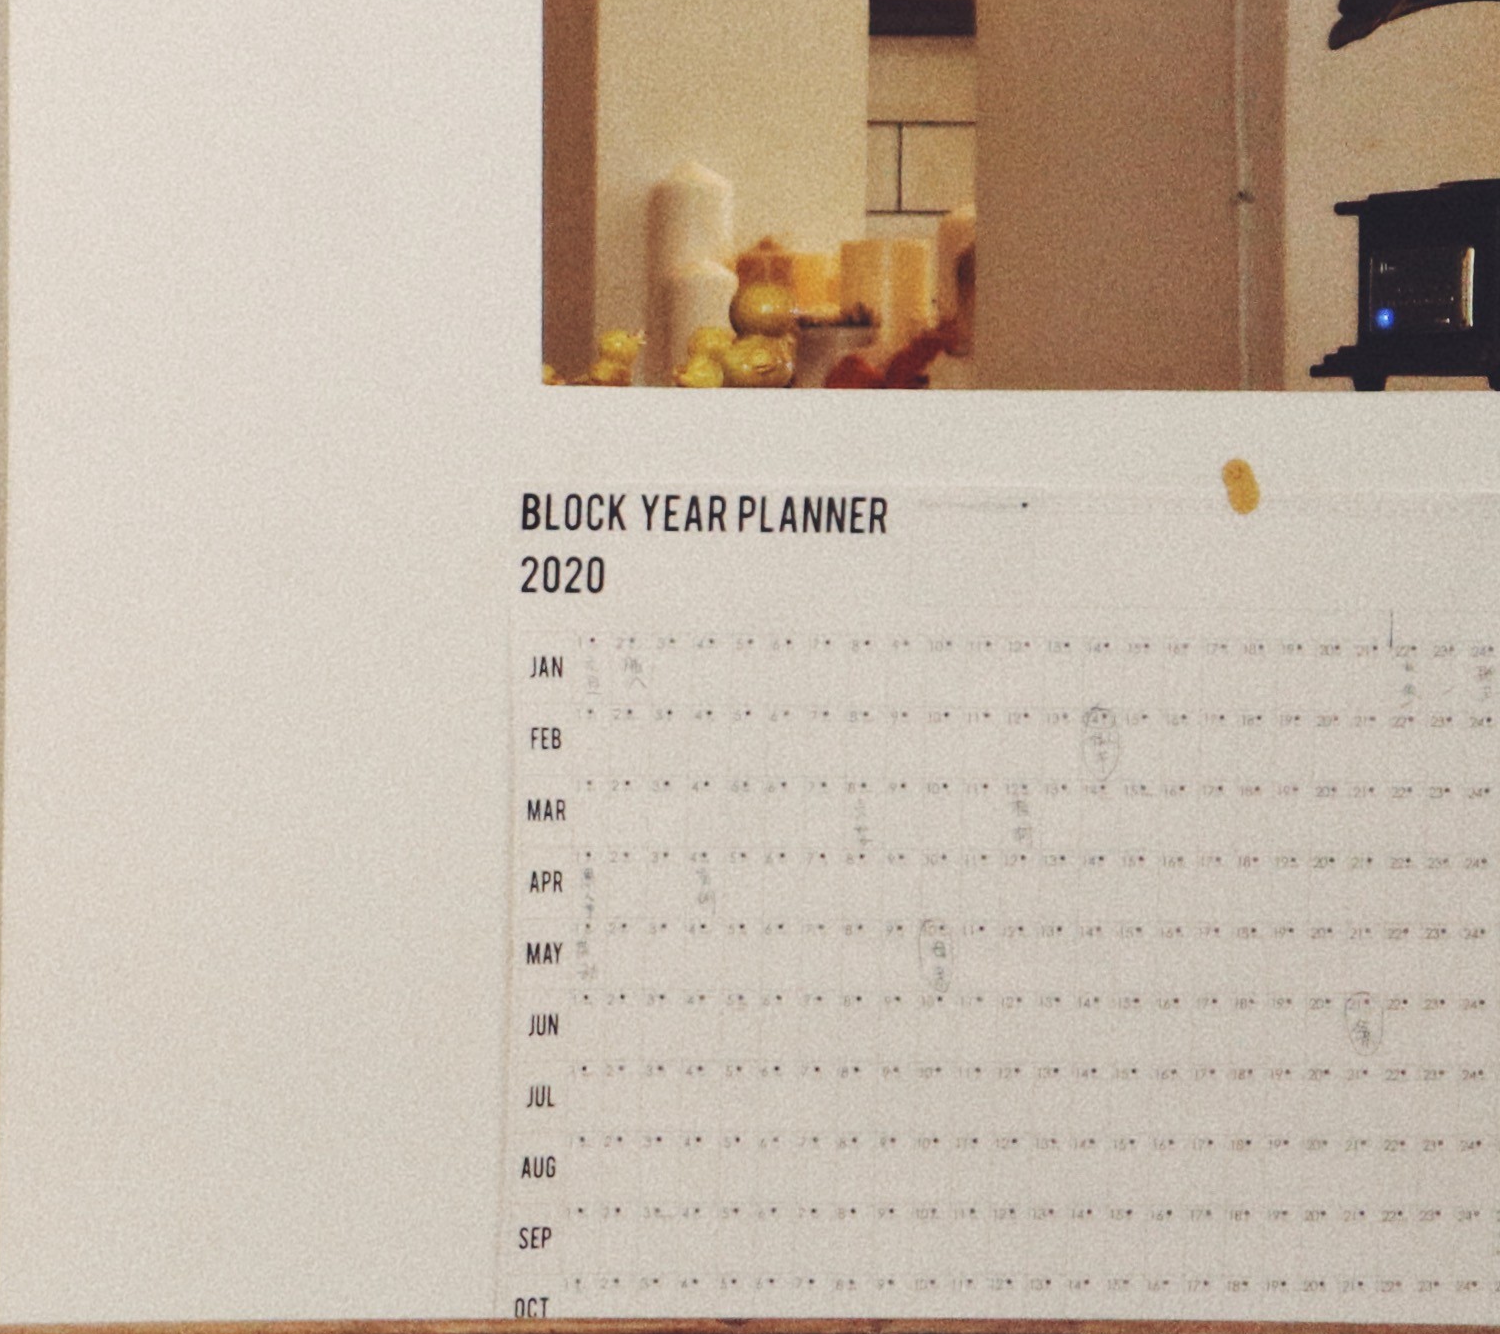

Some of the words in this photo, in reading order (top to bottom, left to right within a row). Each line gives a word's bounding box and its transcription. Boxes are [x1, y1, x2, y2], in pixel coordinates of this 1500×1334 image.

[521, 493, 627, 531] BLOCK
[641, 494, 728, 532] YEAR
[738, 495, 889, 534] PLANNER
[521, 556, 606, 594] 2020
[530, 656, 564, 679] JAN
[531, 728, 563, 751] FEB
[527, 799, 567, 822] MAR
[530, 871, 564, 894] APR
[526, 942, 563, 966] MAY
[528, 1014, 559, 1037] JUN
[527, 1085, 555, 1109] JUL
[521, 1156, 556, 1180] AUG
[518, 1227, 552, 1250] SEP
[514, 1297, 550, 1319] OCT
